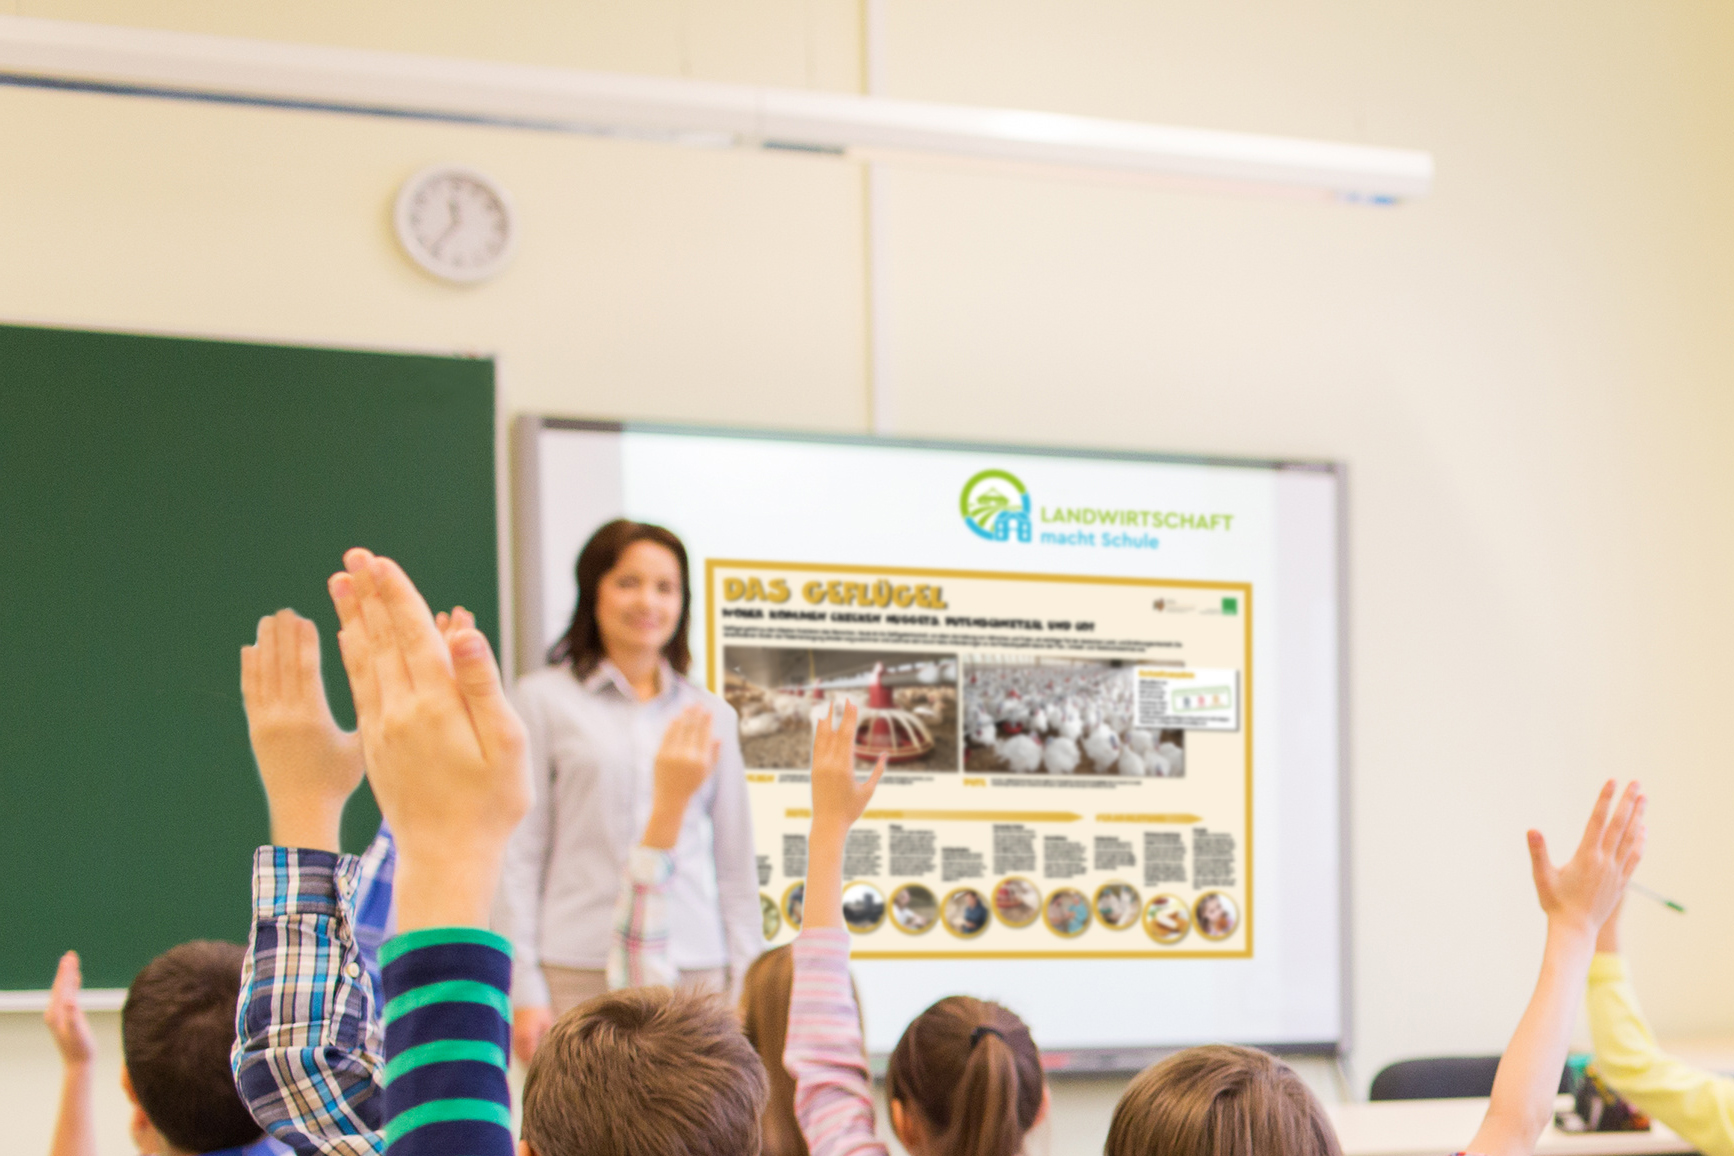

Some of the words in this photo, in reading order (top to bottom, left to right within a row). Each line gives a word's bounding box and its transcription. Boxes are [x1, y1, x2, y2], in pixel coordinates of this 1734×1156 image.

[1040, 506, 1234, 531] LANDWIRTSCHAFT
[1040, 530, 1096, 546] macht
[1101, 531, 1160, 550] Schule
[723, 577, 791, 604] DAS
[802, 579, 948, 609] GEFLÜGEL
